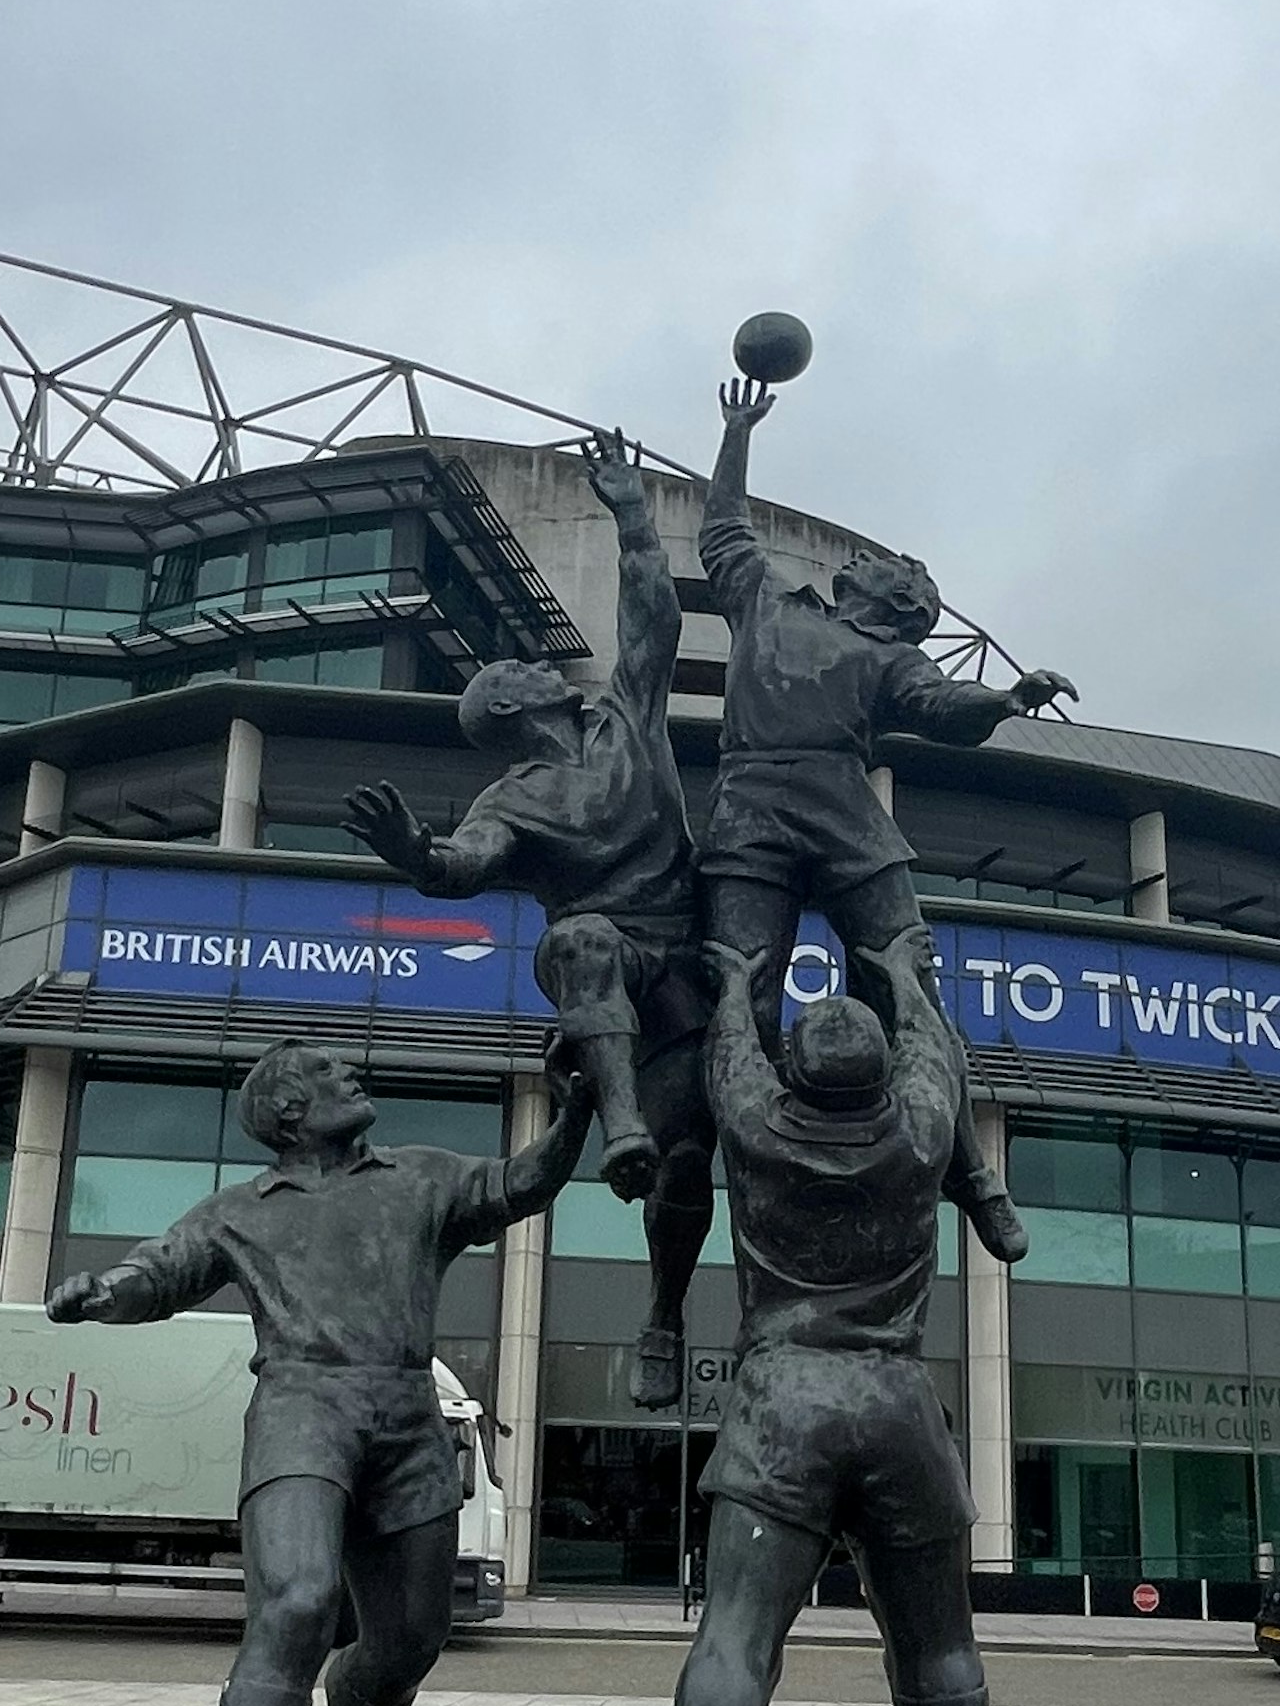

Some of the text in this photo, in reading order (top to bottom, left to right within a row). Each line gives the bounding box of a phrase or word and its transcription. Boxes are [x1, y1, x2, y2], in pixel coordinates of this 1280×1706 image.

[101, 929, 418, 978] BRITISH AIRWAYS
[965, 958, 1064, 1022] TO
[1096, 1377, 1192, 1405] VIRGIN
[1121, 1412, 1272, 1442] HEALTH CLUB
[56, 1437, 132, 1474] linen
